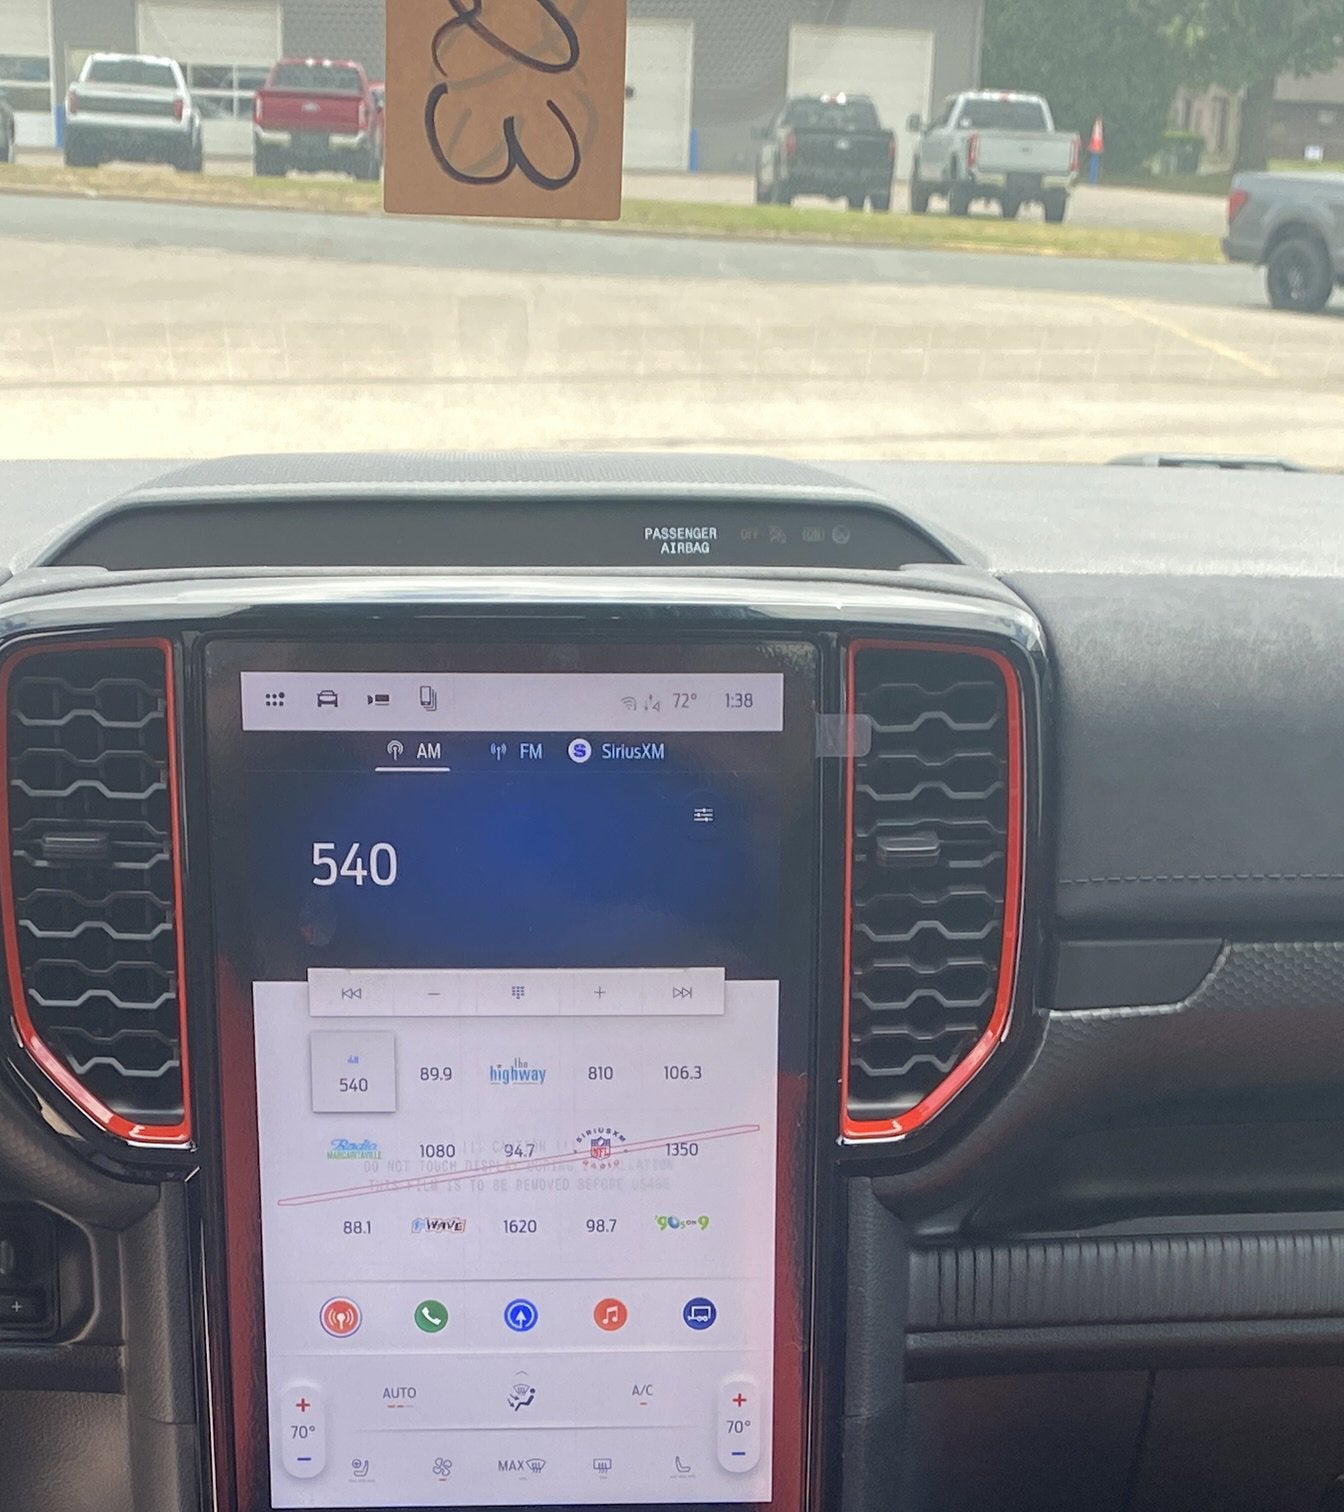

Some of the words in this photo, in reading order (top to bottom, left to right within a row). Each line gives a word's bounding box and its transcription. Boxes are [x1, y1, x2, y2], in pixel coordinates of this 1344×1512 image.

[644, 527, 717, 540] PASSENGER
[660, 542, 710, 554] AIRBAG
[672, 692, 697, 709] 72°
[724, 692, 753, 709] 1:38
[417, 743, 442, 759] AM
[520, 743, 543, 759] FM
[602, 741, 665, 760] SiriusXM
[313, 842, 398, 886] 540
[420, 1066, 452, 1082] 89.9
[490, 1064, 546, 1086] highway
[588, 1066, 613, 1081] 810
[663, 1065, 702, 1081] 106.3
[339, 1078, 368, 1093] 540
[576, 1128, 626, 1144] SIRIUSXM
[330, 1139, 378, 1151] Radio
[419, 1144, 455, 1158] 1080
[504, 1143, 535, 1159] 94.7
[665, 1142, 698, 1157] 1350
[364, 1161, 378, 1172] DO
[387, 1161, 408, 1172] NOT
[420, 1161, 456, 1172] TOUCH
[445, 1180, 460, 1191] IS
[469, 1180, 484, 1191] TO
[493, 1180, 508, 1191] BE
[516, 1179, 570, 1191] REMOVED
[343, 1220, 372, 1235] 88.1
[503, 1219, 537, 1235] 1620
[586, 1218, 617, 1234] 98.7
[382, 1387, 417, 1400] AUTO
[632, 1384, 653, 1397] A/C
[291, 1425, 316, 1440] 70°
[726, 1420, 751, 1434] 70°
[498, 1459, 524, 1472] MAX
